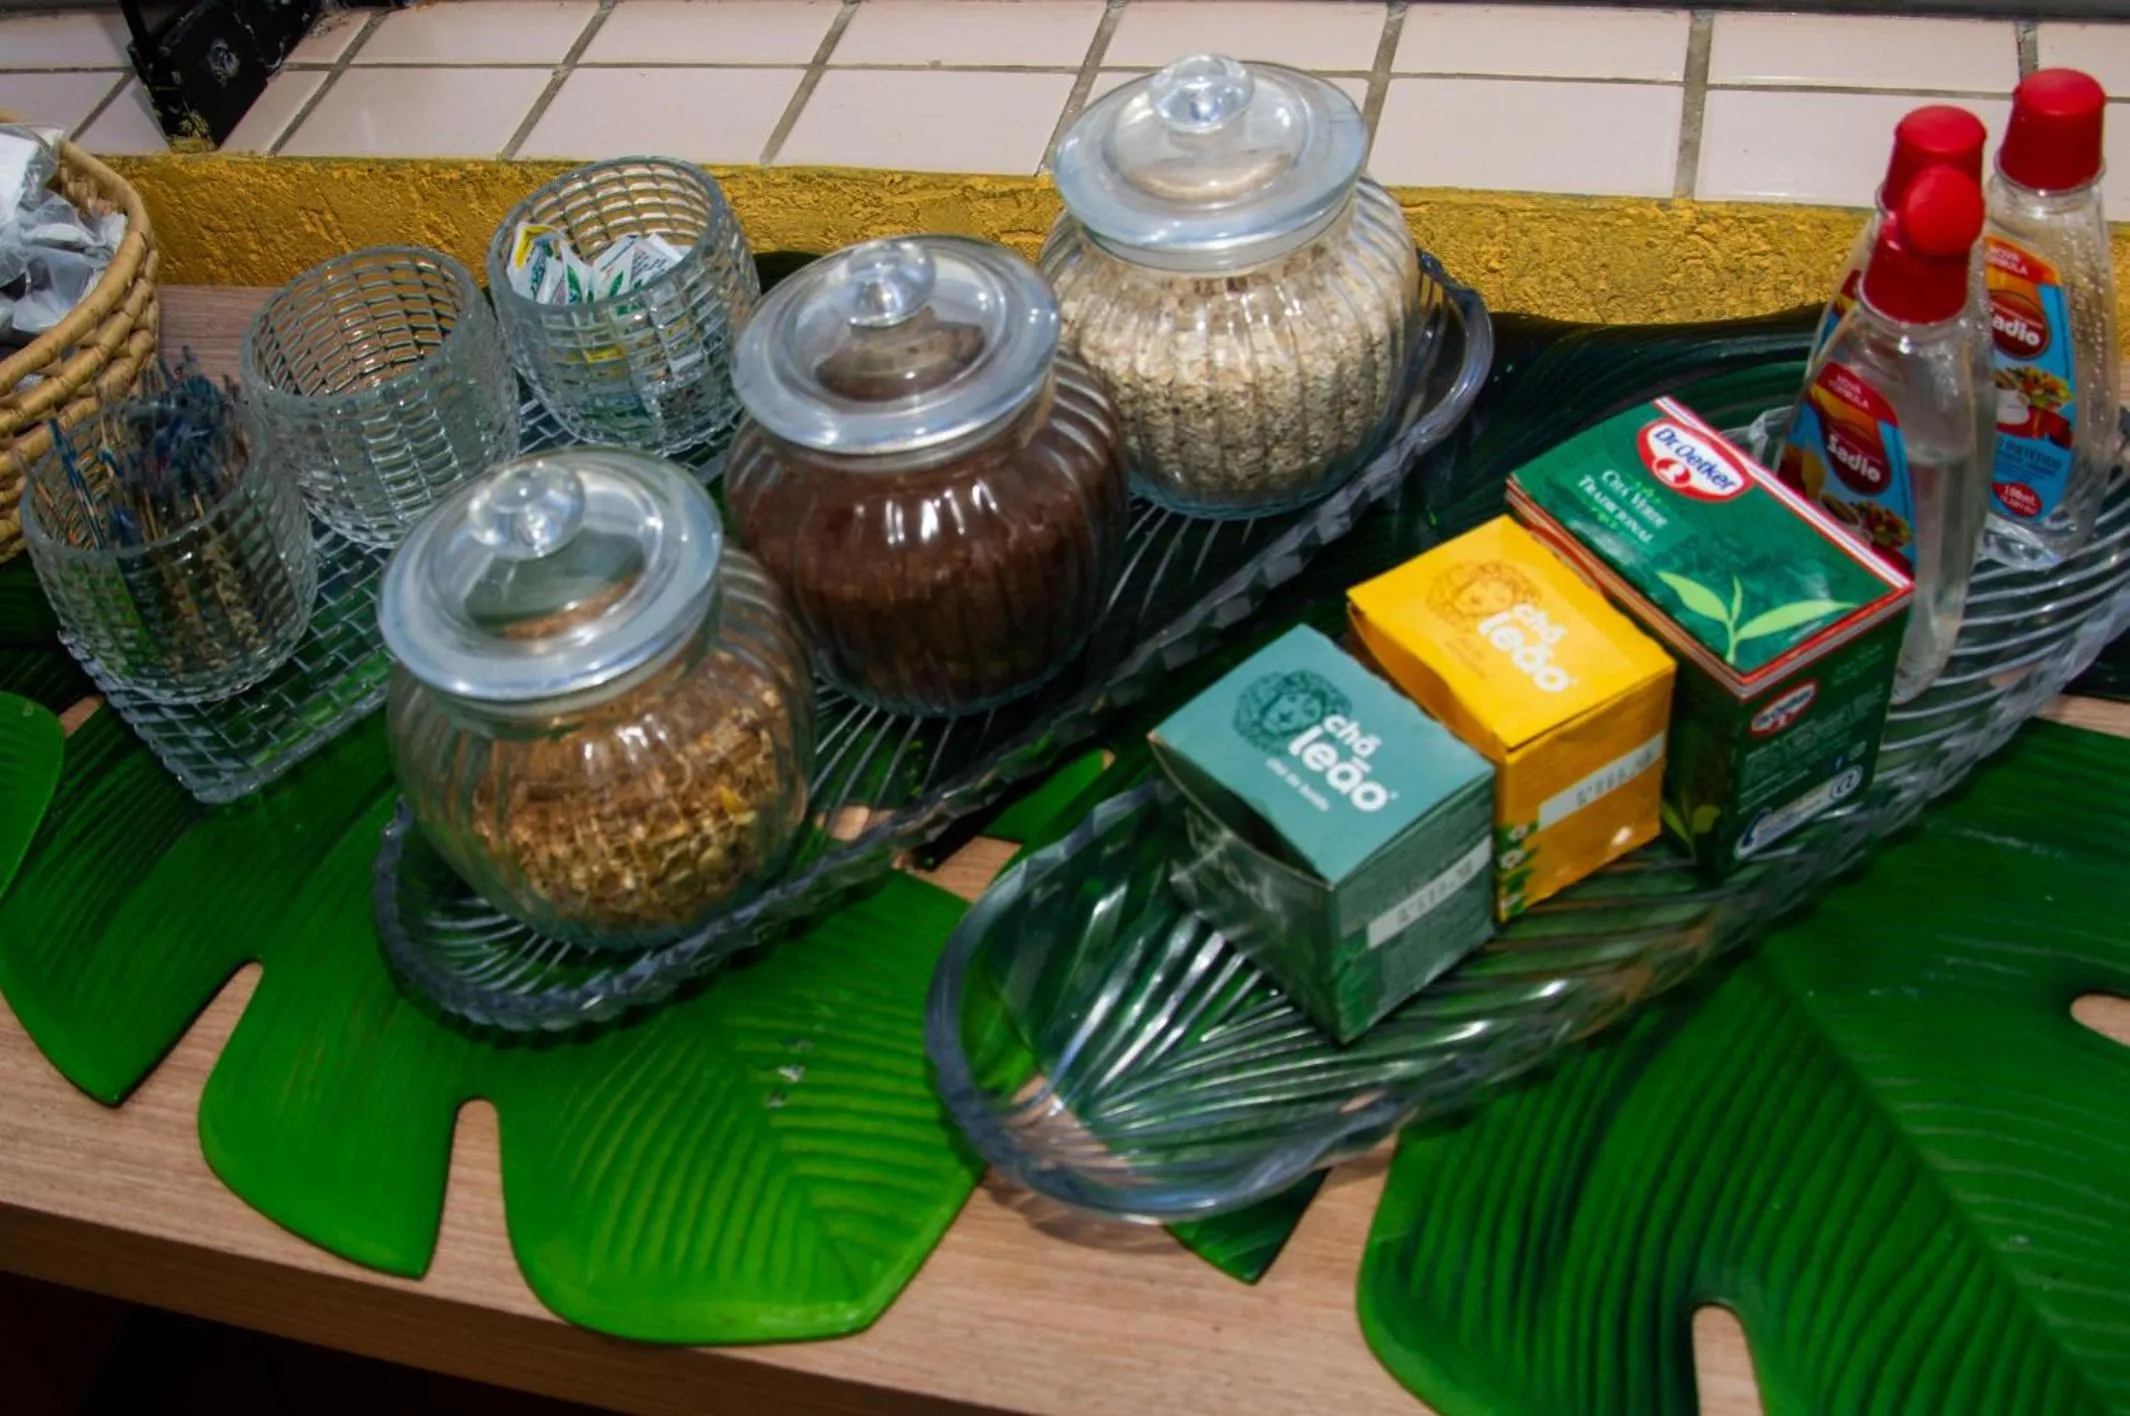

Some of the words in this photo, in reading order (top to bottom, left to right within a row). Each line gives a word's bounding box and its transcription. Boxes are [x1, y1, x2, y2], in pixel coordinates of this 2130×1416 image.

[1675, 444, 1737, 491] Oetker
[1513, 603, 1567, 644] chá
[1478, 611, 1569, 692] leão
[1323, 714, 1382, 757] chá
[1288, 724, 1379, 812] leão
